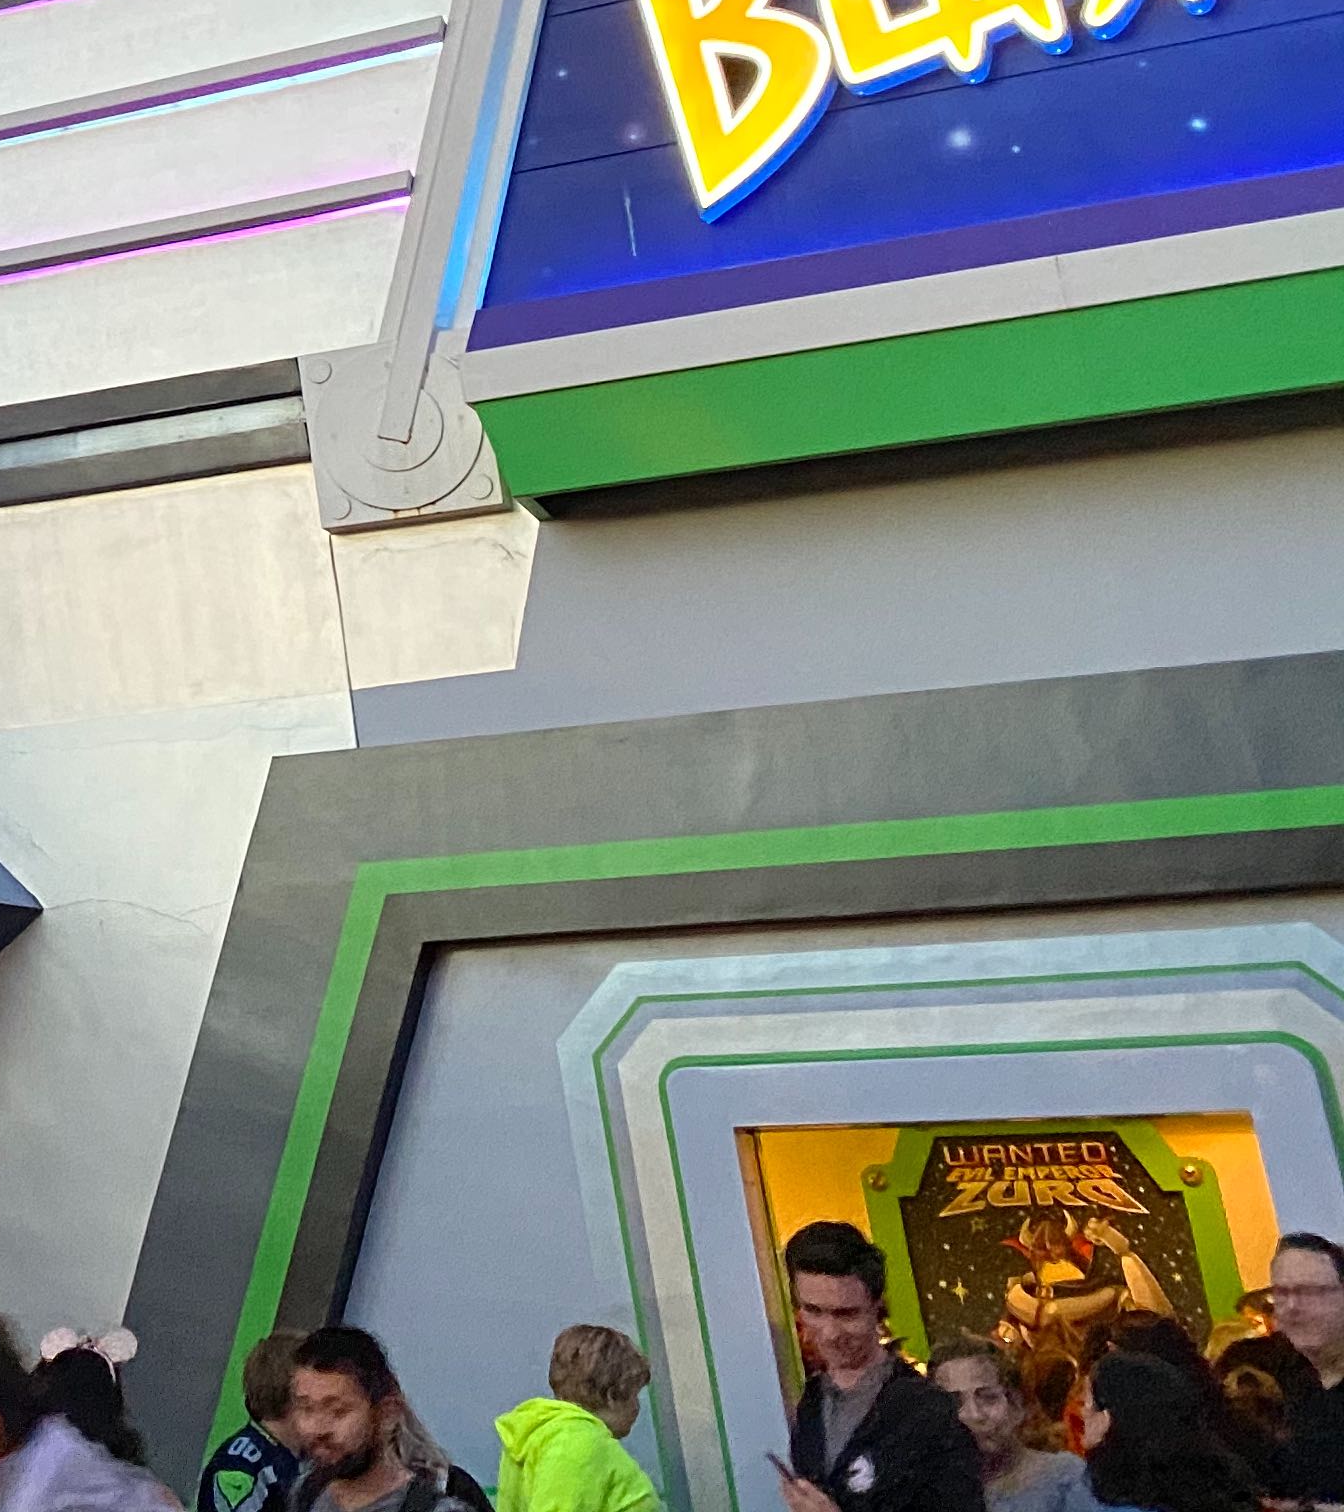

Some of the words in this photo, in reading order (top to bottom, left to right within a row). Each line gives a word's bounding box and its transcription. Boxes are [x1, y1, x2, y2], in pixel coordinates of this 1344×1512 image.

[942, 1141, 1107, 1167] WANTED
[946, 1166, 996, 1183] EVIL
[1003, 1164, 1123, 1181] EMPEROR
[938, 1178, 1151, 1218] ZURG
